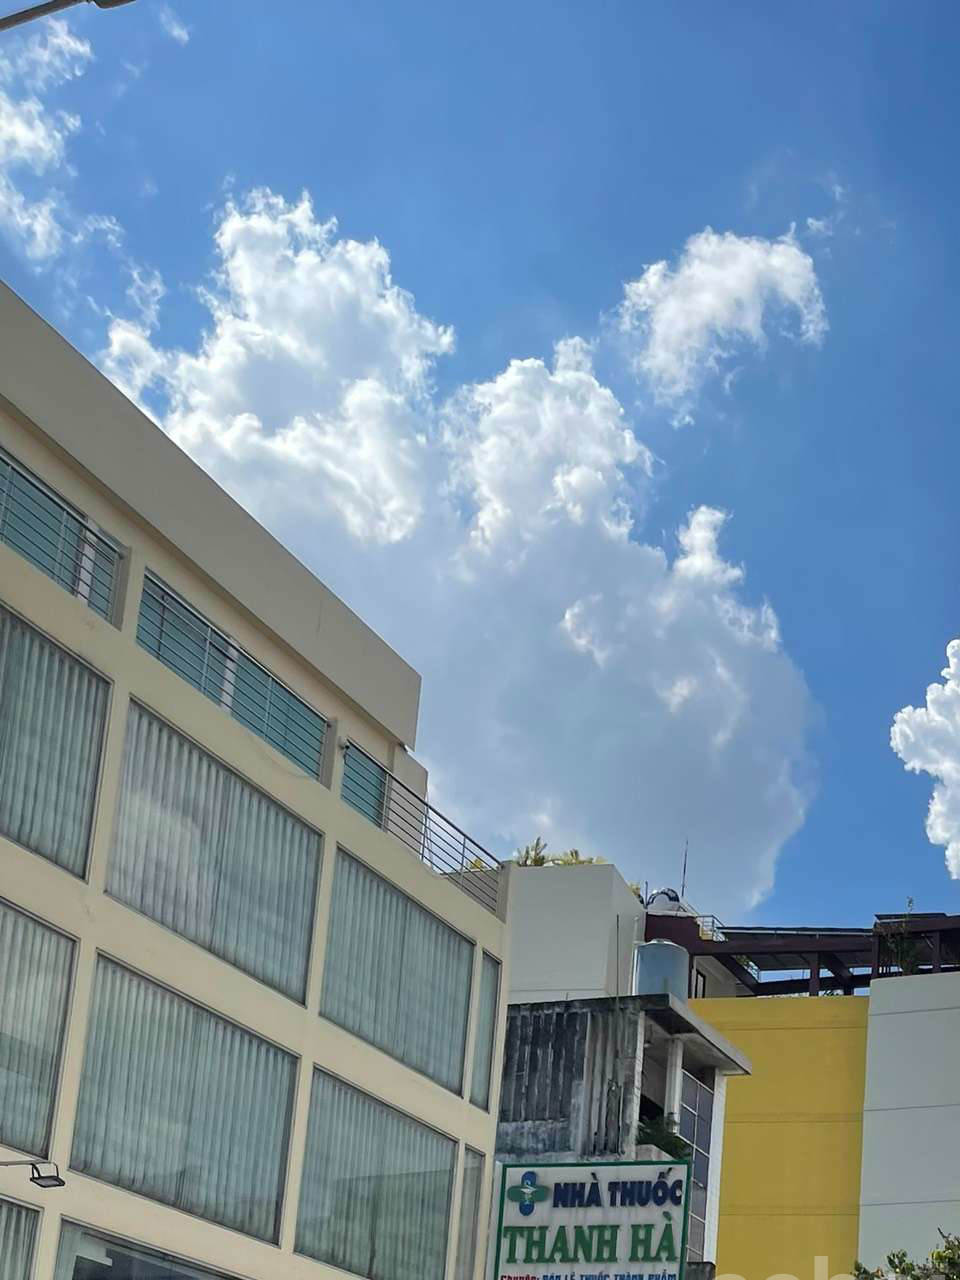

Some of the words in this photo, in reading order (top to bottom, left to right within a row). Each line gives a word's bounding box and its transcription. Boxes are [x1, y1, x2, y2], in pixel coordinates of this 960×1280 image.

[553, 1172, 603, 1208] NHÀ
[608, 1167, 684, 1208] THUỐC
[503, 1224, 620, 1264] THANH
[628, 1211, 677, 1264] HÀ
